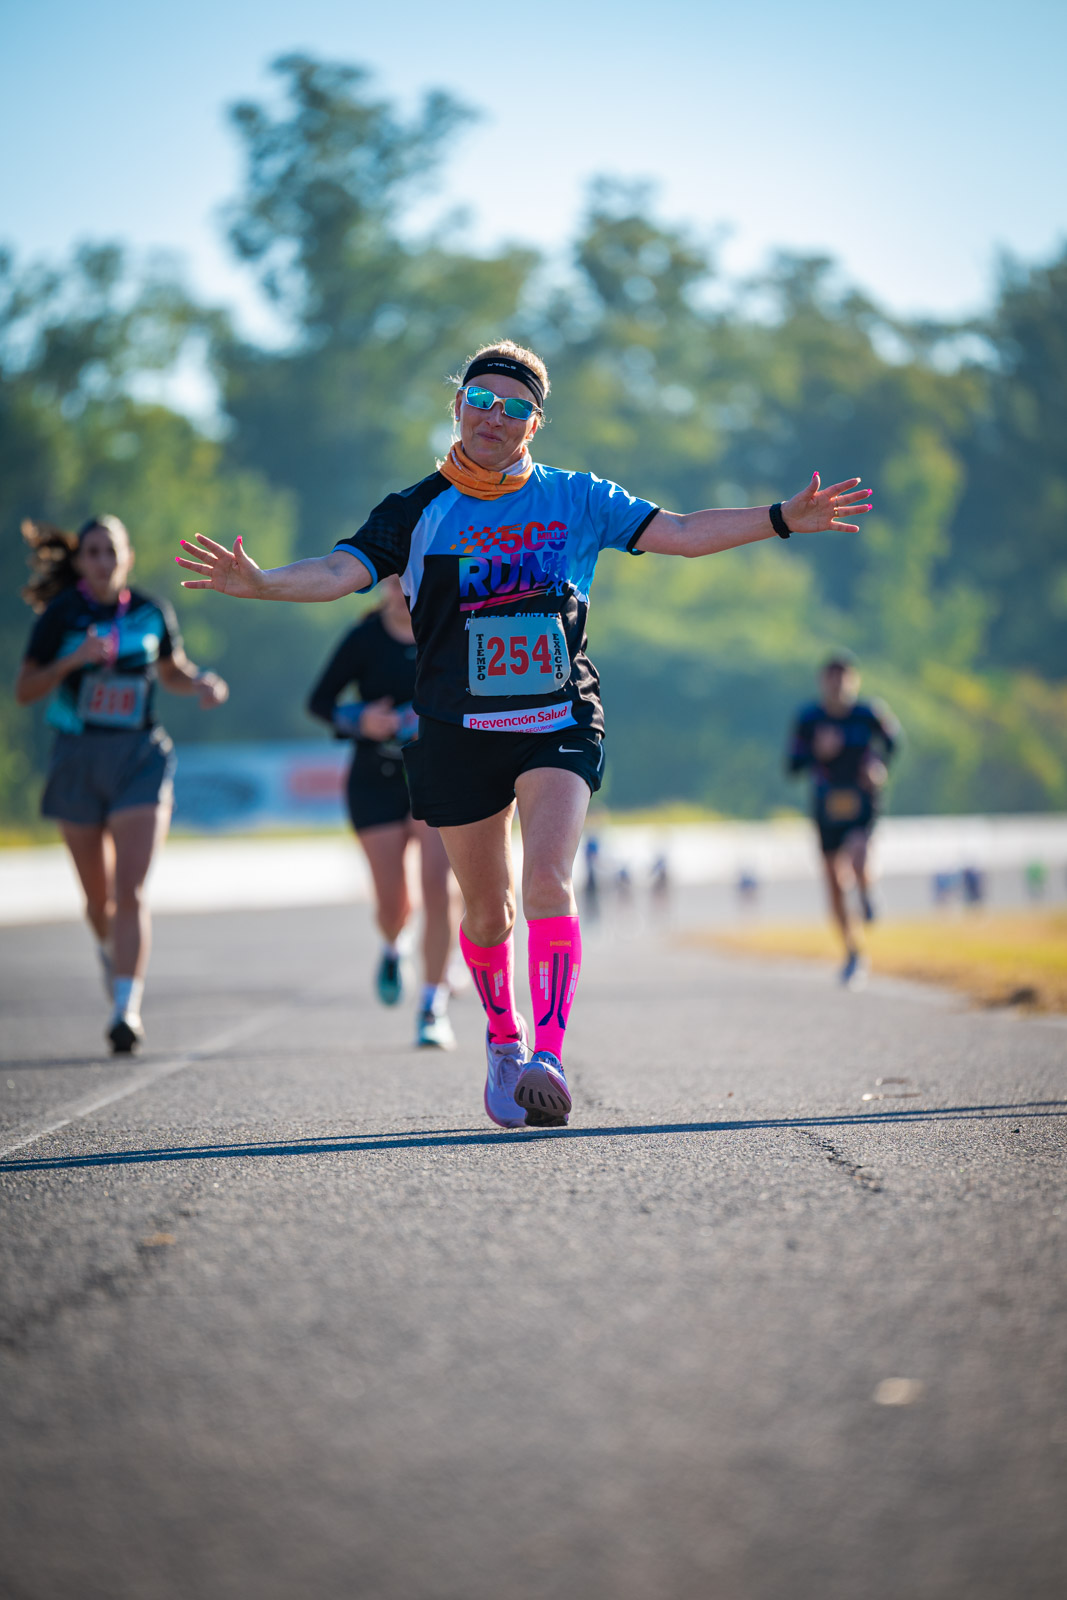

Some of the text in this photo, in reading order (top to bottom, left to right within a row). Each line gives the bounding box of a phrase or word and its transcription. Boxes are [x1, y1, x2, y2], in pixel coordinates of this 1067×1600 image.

[459, 552, 567, 598] RUN
[476, 633, 486, 681] TIEMPO
[487, 634, 553, 676] 254
[552, 633, 564, 680] EXACTO
[469, 706, 568, 729] Prevención Salud
